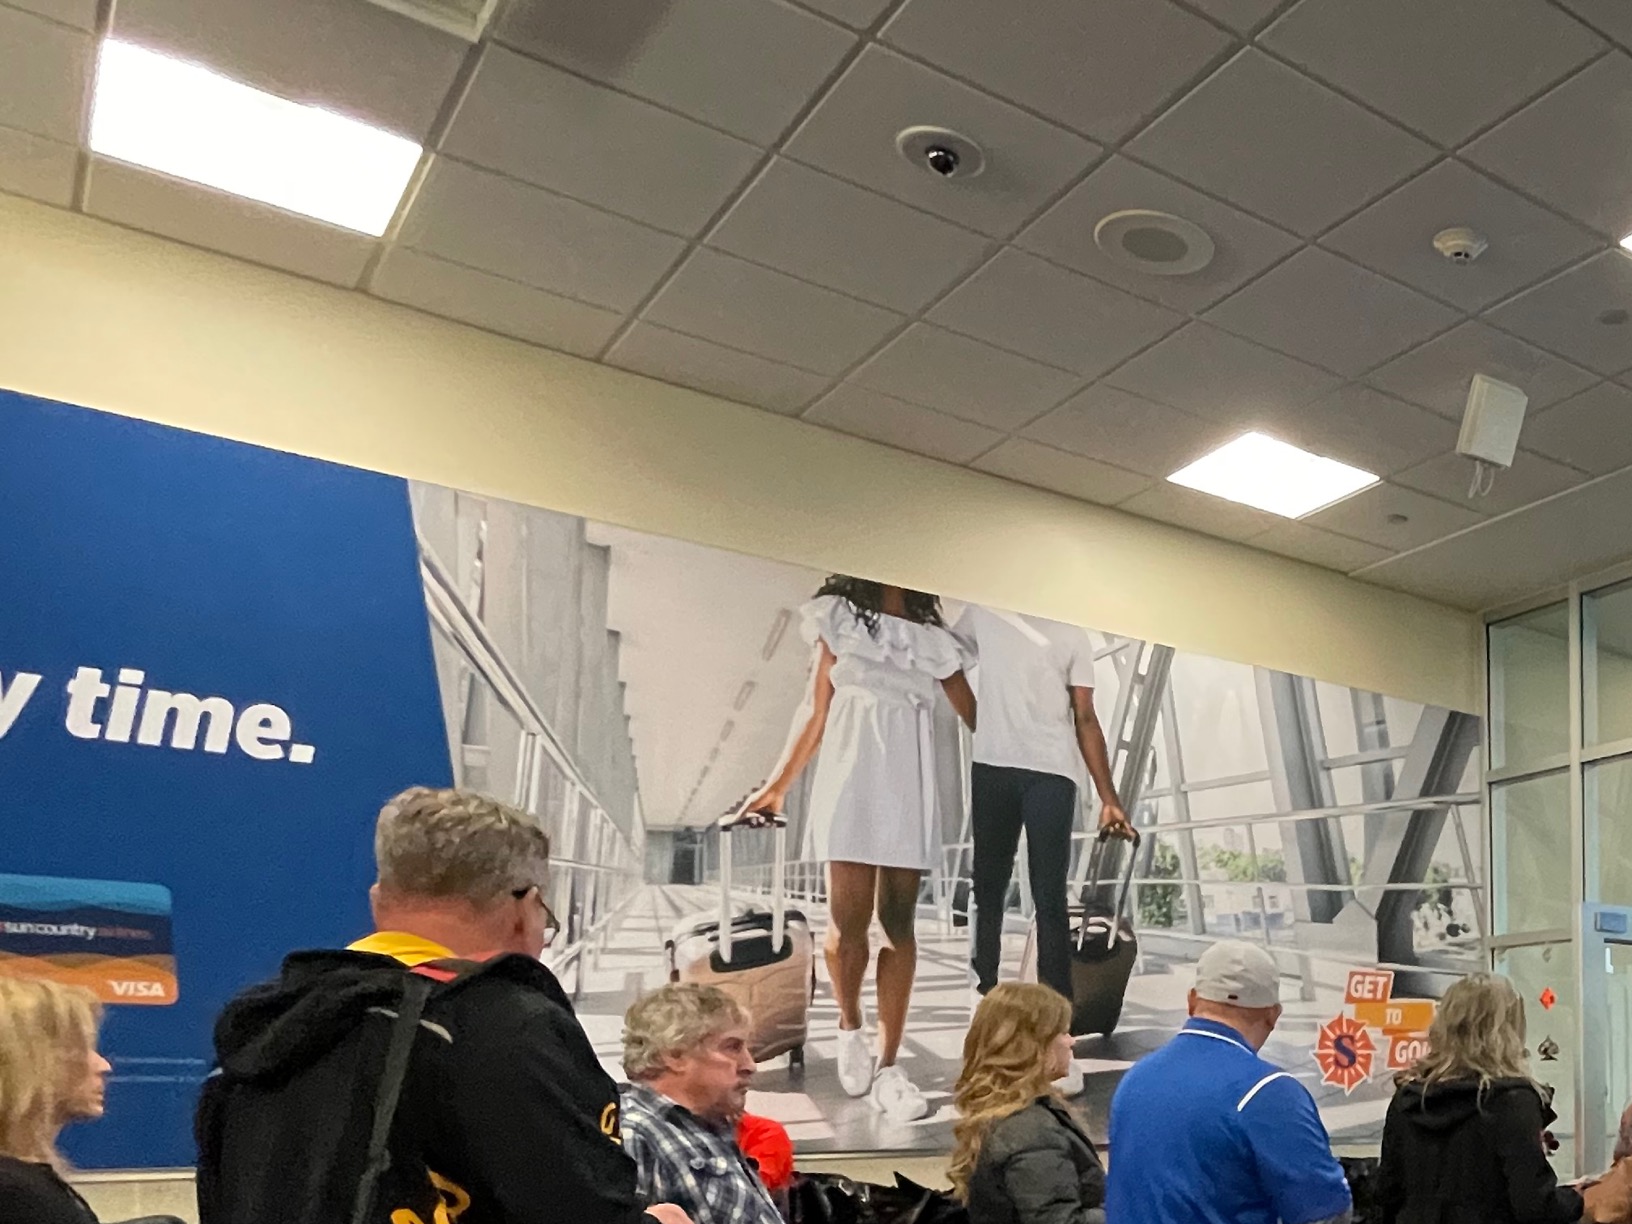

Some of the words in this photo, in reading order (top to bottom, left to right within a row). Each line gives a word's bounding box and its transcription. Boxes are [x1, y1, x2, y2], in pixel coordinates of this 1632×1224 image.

[65, 666, 316, 764] time.
[107, 980, 166, 997] VISA
[1350, 975, 1388, 999] GET
[1385, 1008, 1402, 1025] TO
